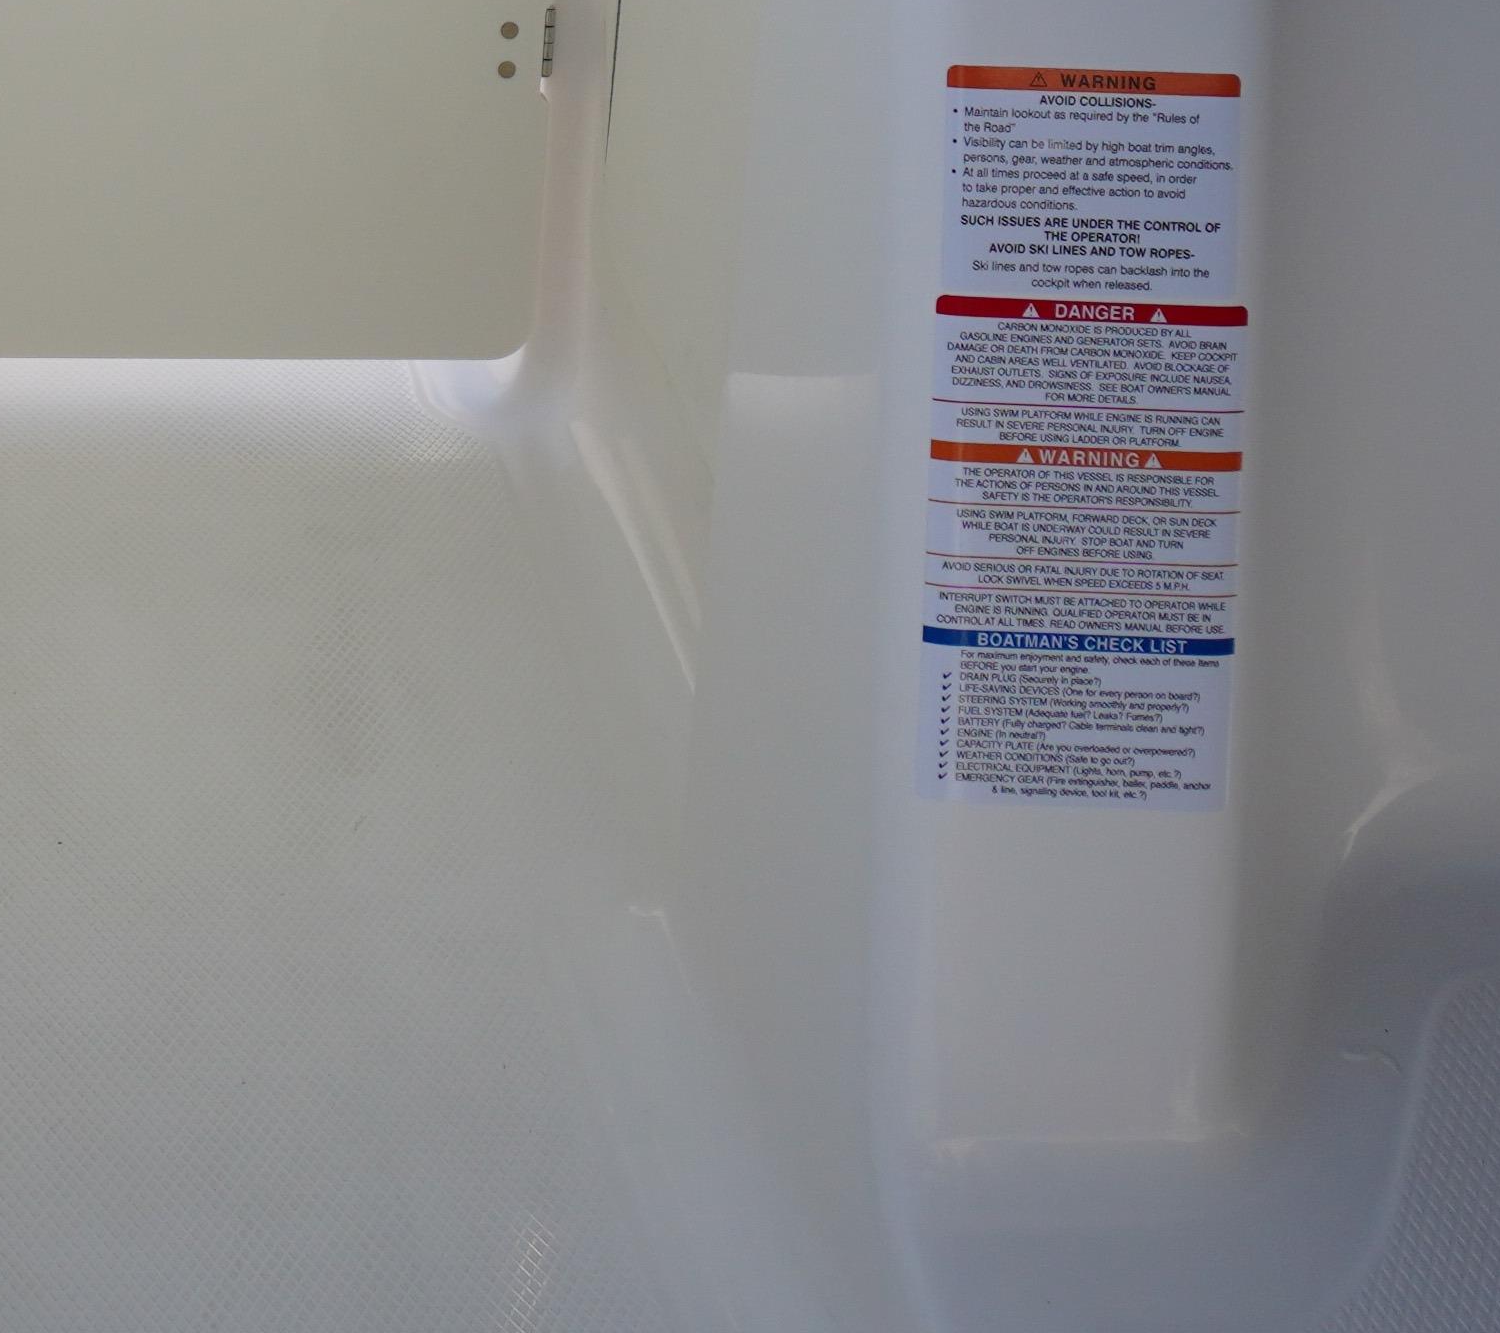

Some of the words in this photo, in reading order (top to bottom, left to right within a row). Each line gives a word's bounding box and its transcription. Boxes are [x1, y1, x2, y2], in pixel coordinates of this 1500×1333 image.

[1061, 74, 1157, 91] WARNING
[1040, 95, 1076, 107] AVOID
[1078, 96, 1156, 109] COLLISIONS-
[965, 107, 1008, 119] Maintain
[1011, 108, 1050, 120] lookout
[1053, 112, 1065, 120] as
[1067, 110, 1113, 125] required
[1116, 111, 1129, 125] by
[1132, 112, 1149, 123] the
[1189, 114, 1199, 125] of
[964, 122, 980, 132] the
[964, 137, 1005, 152] Visibility
[1008, 141, 1027, 149] can
[1030, 139, 1044, 150] be
[1047, 140, 1082, 151] limited
[1085, 141, 1098, 154] by
[1101, 141, 1124, 155] high
[1127, 142, 1151, 153] boat
[1154, 143, 1174, 154] trim
[1177, 143, 1215, 158] angles,
[964, 155, 1008, 167] persons,
[1009, 156, 1036, 168] gear,
[1040, 155, 1081, 166] weather
[1085, 156, 1105, 167] and
[1108, 156, 1174, 172] atmospheric
[1175, 158, 1232, 170] conditions.
[963, 167, 973, 178] At
[976, 168, 988, 179] all
[991, 168, 1019, 180] times
[1021, 169, 1066, 184] proceed
[1069, 171, 1079, 181] at
[1082, 173, 1088, 182] a
[1091, 171, 1113, 183] safe
[1116, 172, 1152, 187] speed,
[1156, 173, 1165, 184] in
[1168, 174, 1196, 185] order
[963, 182, 972, 193] to
[975, 183, 997, 194] take
[998, 186, 1034, 198] proper
[1038, 185, 1058, 196] and
[1061, 185, 1105, 197] effective
[1108, 187, 1140, 198] action
[1143, 188, 1154, 198] to
[1156, 188, 1185, 199] avoid
[962, 198, 1016, 209] hazardous
[1018, 199, 1078, 211] conditions.
[961, 215, 993, 227] SUCH
[997, 216, 1040, 228] ISSUES
[1044, 217, 1067, 229] ARE
[1072, 218, 1113, 230] UNDER
[1118, 220, 1139, 231] THE
[1143, 220, 1200, 233] CONTROL
[1205, 222, 1220, 234] OF
[1045, 231, 1066, 242] THE
[1071, 232, 1140, 244] OPERATOR!
[989, 243, 1025, 255] AVOID
[1029, 244, 1048, 256] SKI
[1052, 245, 1086, 257] LINES
[1090, 246, 1115, 258] AND
[1119, 247, 1145, 259] TOW
[1149, 248, 1195, 260] ROPES-
[973, 261, 988, 272] Ski
[991, 261, 1015, 273] lines
[1019, 262, 1039, 273] and
[1041, 263, 1061, 274] tow
[1064, 266, 1094, 278] ropes
[1097, 267, 1117, 276] can
[1119, 265, 1167, 277] backlash
[1170, 267, 1190, 278] into
[1193, 267, 1209, 278] the
[1032, 278, 1069, 292] cockpit
[1072, 279, 1101, 290] when
[1104, 279, 1152, 291] released.
[1055, 305, 1135, 321] DANGER
[1040, 449, 1140, 468] WARNING
[977, 635, 1078, 651] BOATMAN'S
[1083, 637, 1143, 652] CHECK
[1149, 638, 1187, 653] LIST
